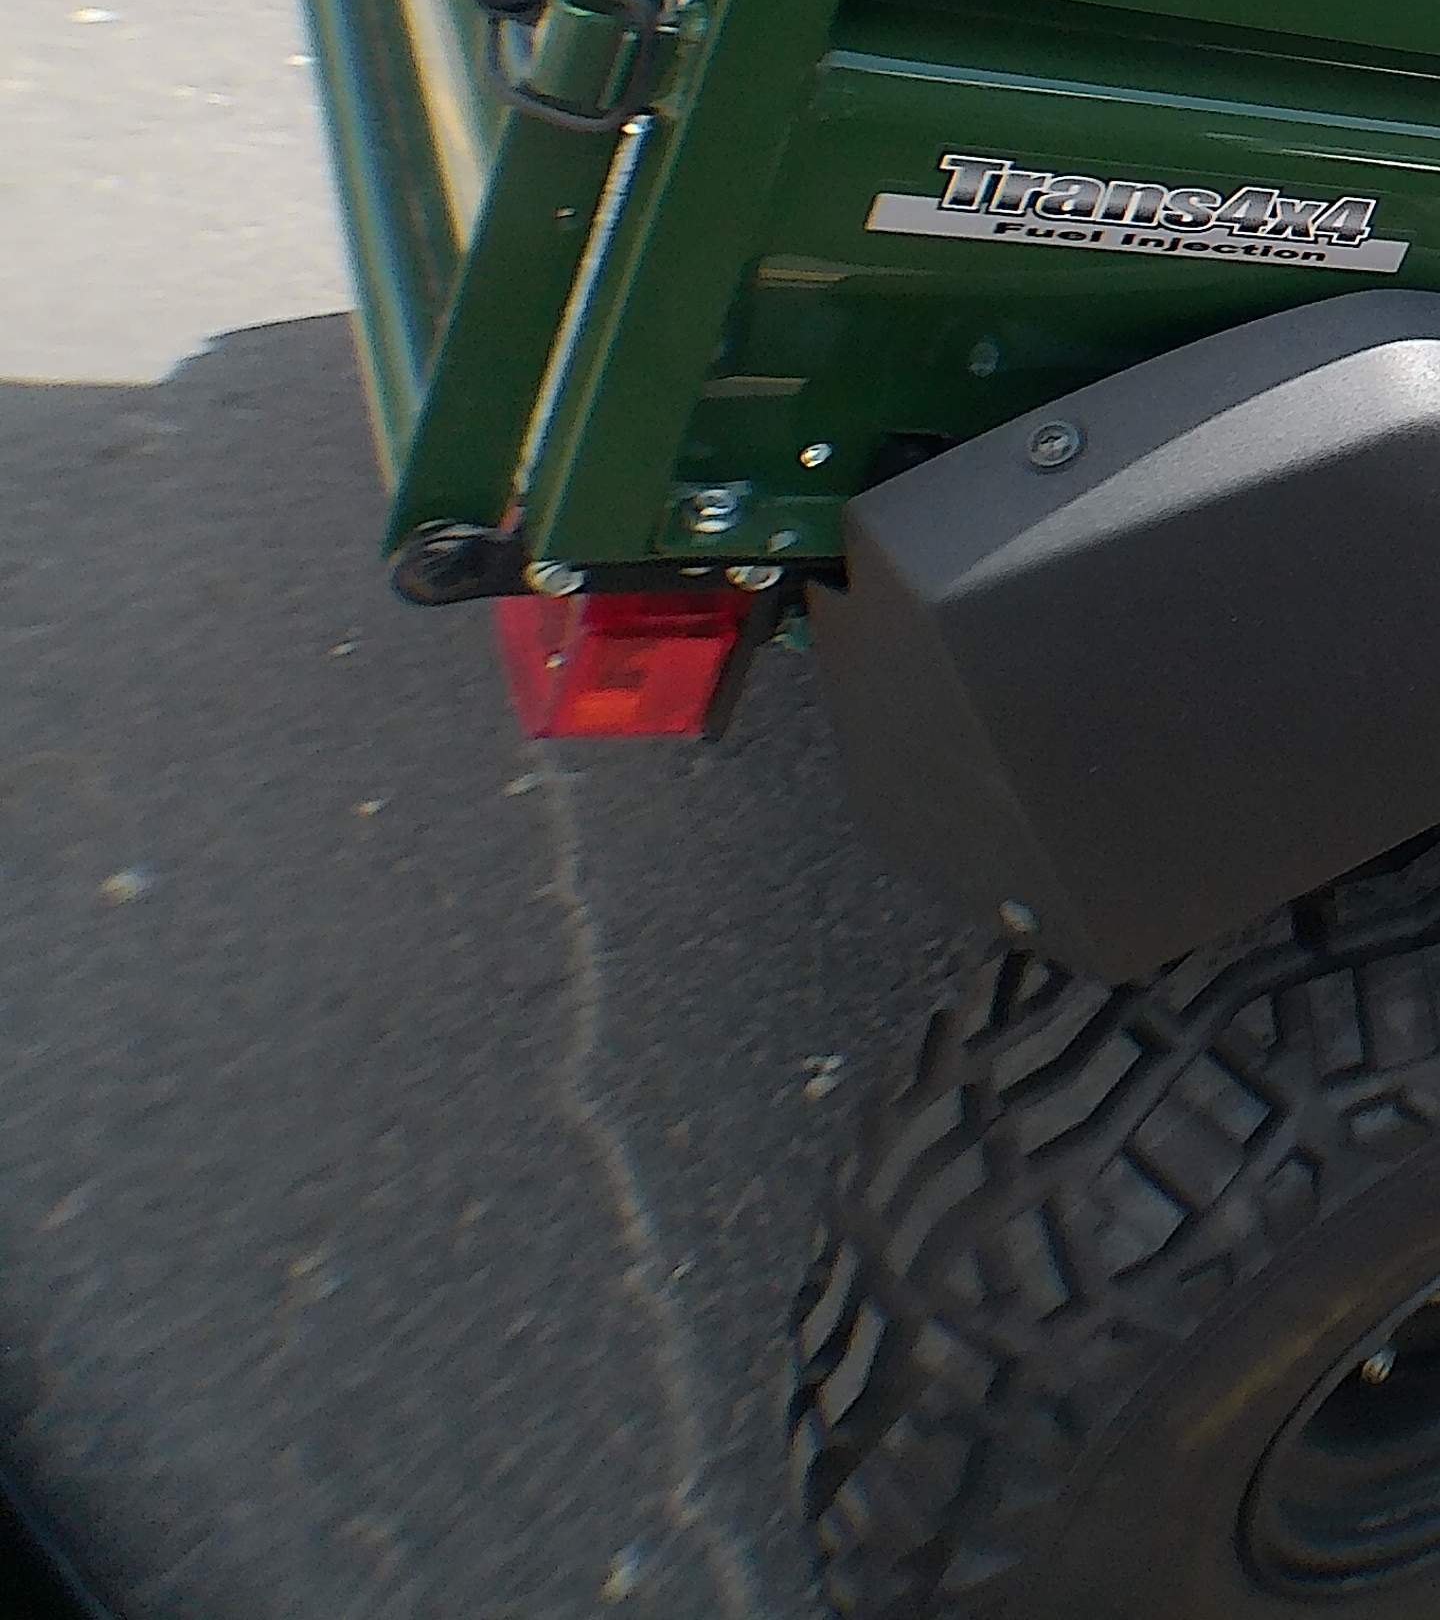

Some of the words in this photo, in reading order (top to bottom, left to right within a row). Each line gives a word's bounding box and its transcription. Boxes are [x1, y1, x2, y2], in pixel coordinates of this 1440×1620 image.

[940, 154, 1377, 246] Trans4x4
[993, 221, 1104, 243] Fuel
[1121, 232, 1328, 262] Injection
